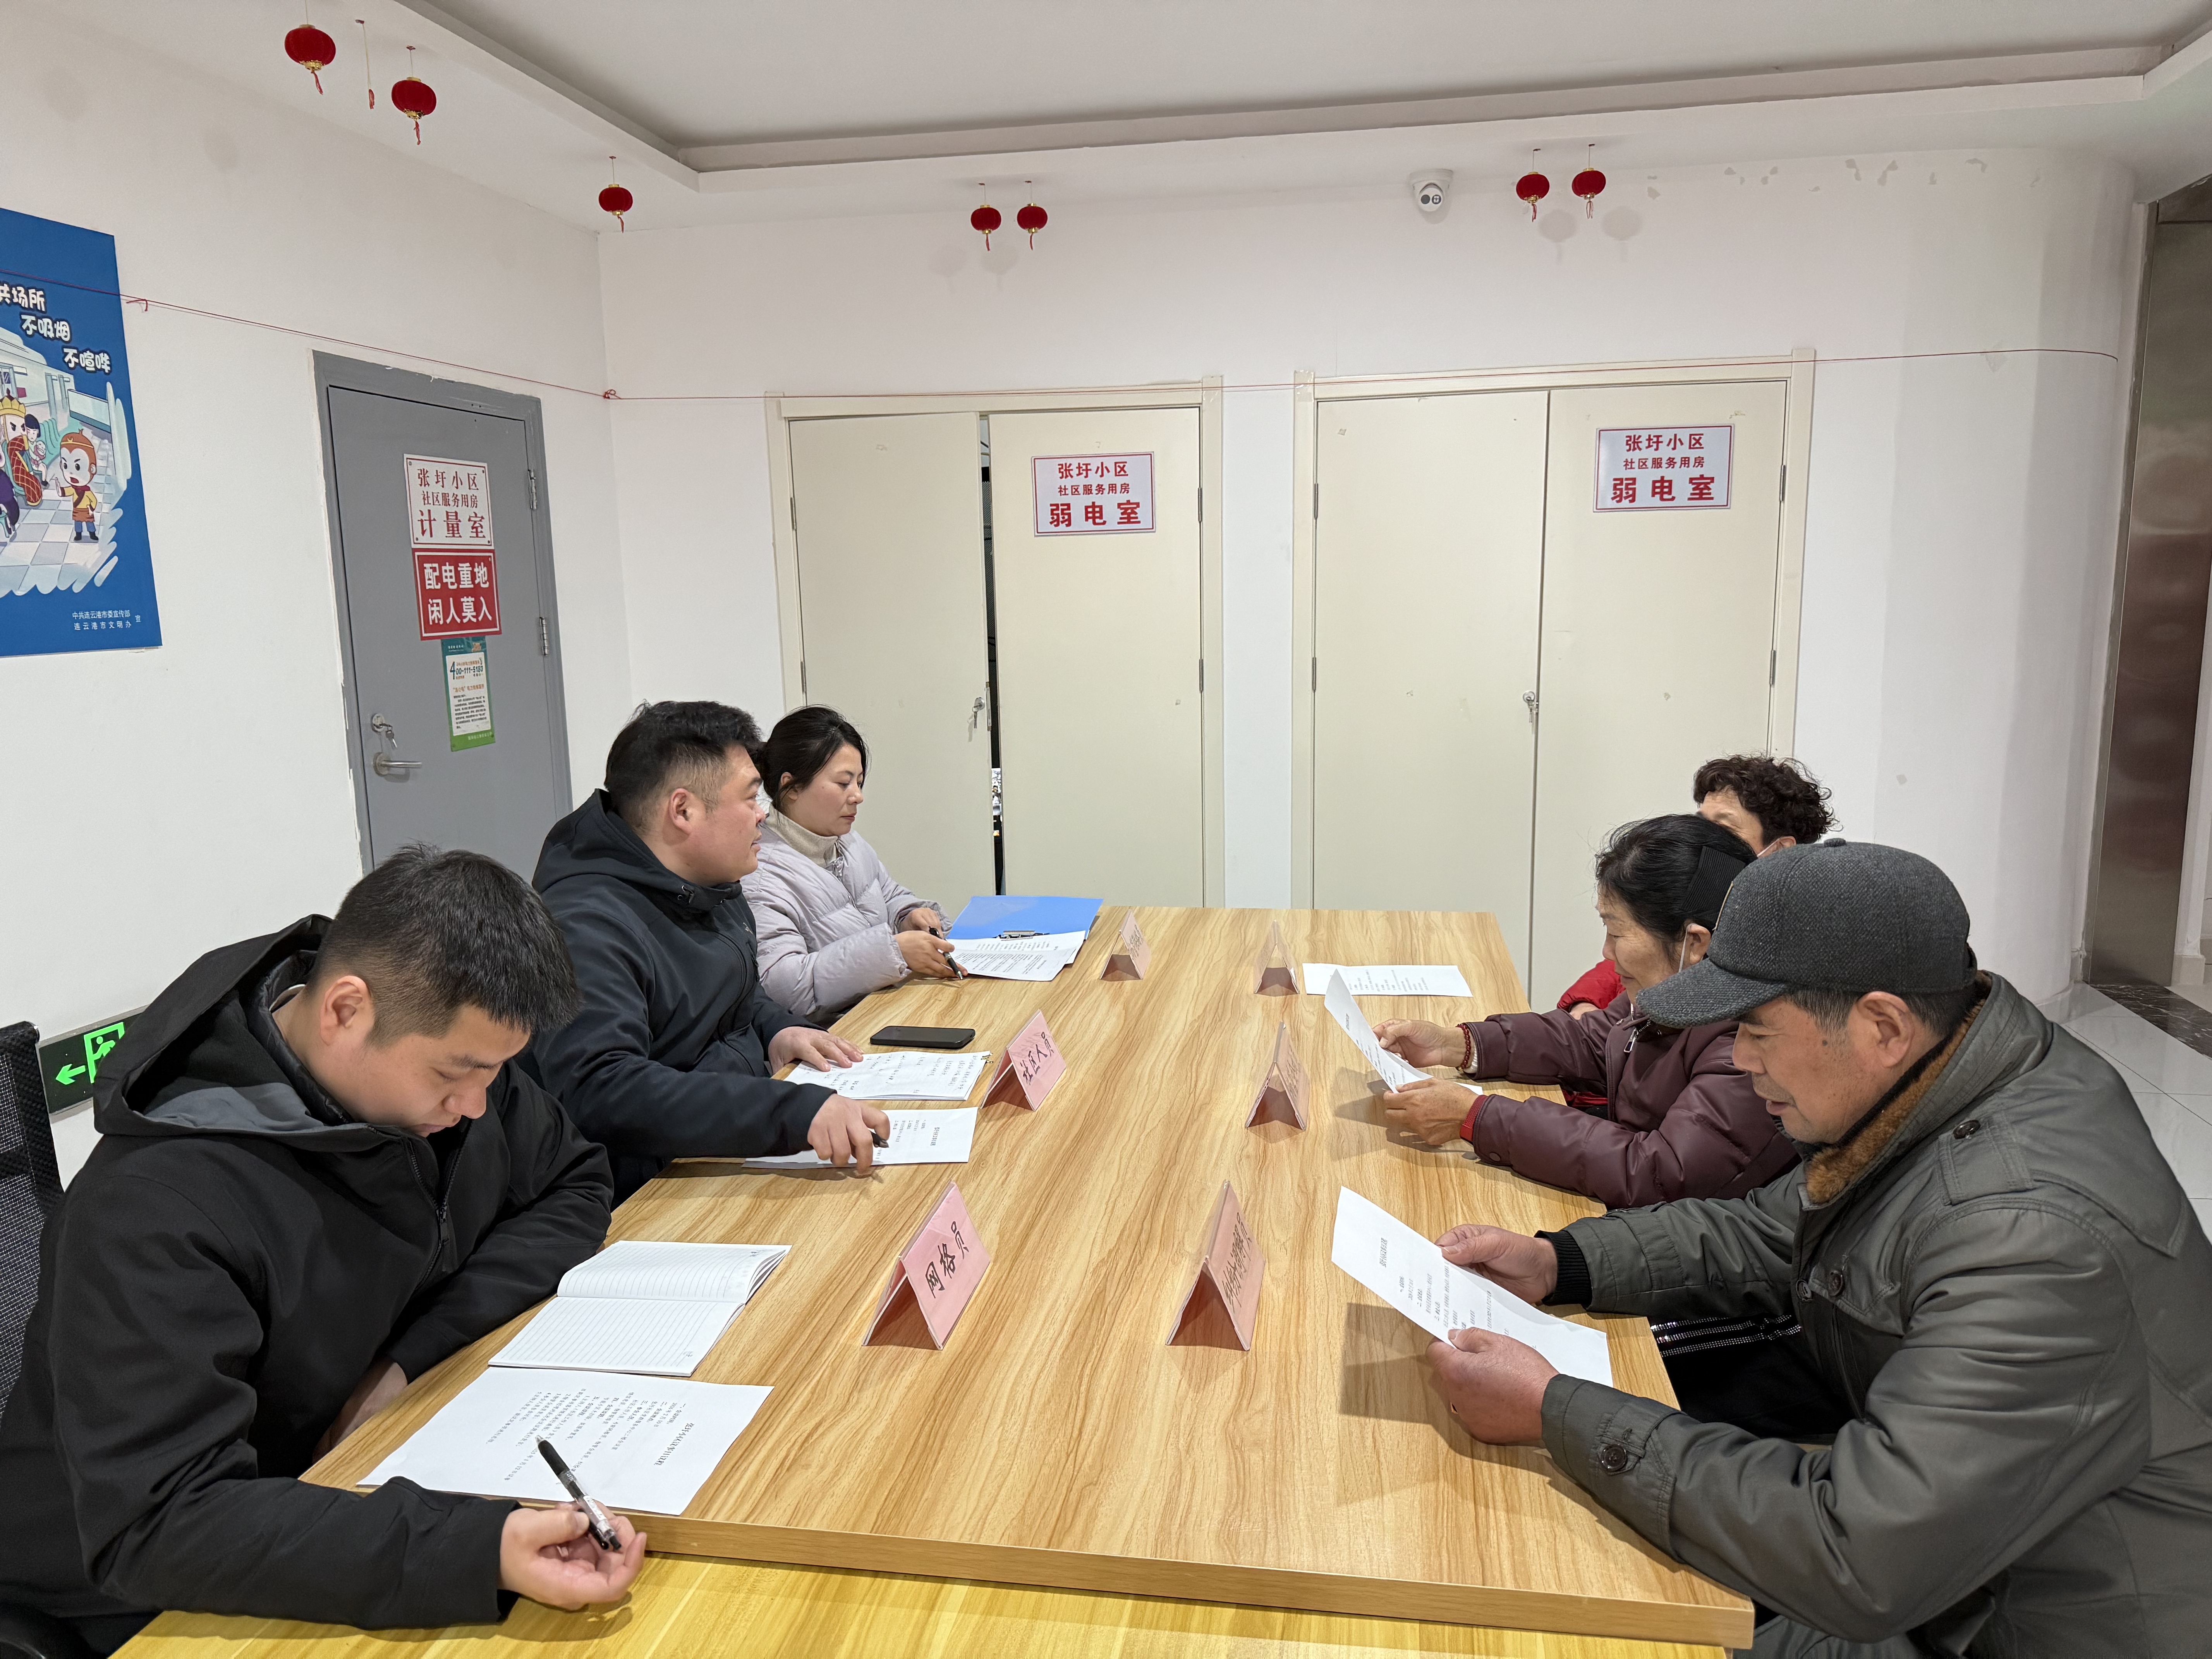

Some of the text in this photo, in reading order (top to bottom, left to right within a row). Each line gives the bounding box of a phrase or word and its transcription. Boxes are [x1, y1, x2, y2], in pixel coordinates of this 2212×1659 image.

[0, 283, 45, 311] 共场所
[21, 314, 70, 342] 不吸烟
[64, 348, 111, 373] 不喧哗
[1625, 433, 1704, 452] 张圩小区
[1058, 461, 1128, 479] 张圩小区
[1623, 456, 1705, 471] 社区服务用房
[417, 468, 479, 491] 张圩小区
[1058, 483, 1130, 496] 社区服务用房
[1611, 474, 1715, 503] 弱电室
[421, 490, 478, 508] 社区服务用房
[417, 509, 486, 539] 计量室
[1049, 500, 1141, 527] 弱电室
[423, 562, 489, 590] 配电重地
[72, 610, 131, 620] 中共连云港市委宣传部
[428, 596, 493, 625] 闲人莫入
[74, 620, 132, 630] 连云港市文明办
[1020, 1031, 1054, 1085] 社区人员
[925, 1221, 969, 1299] 网格员
